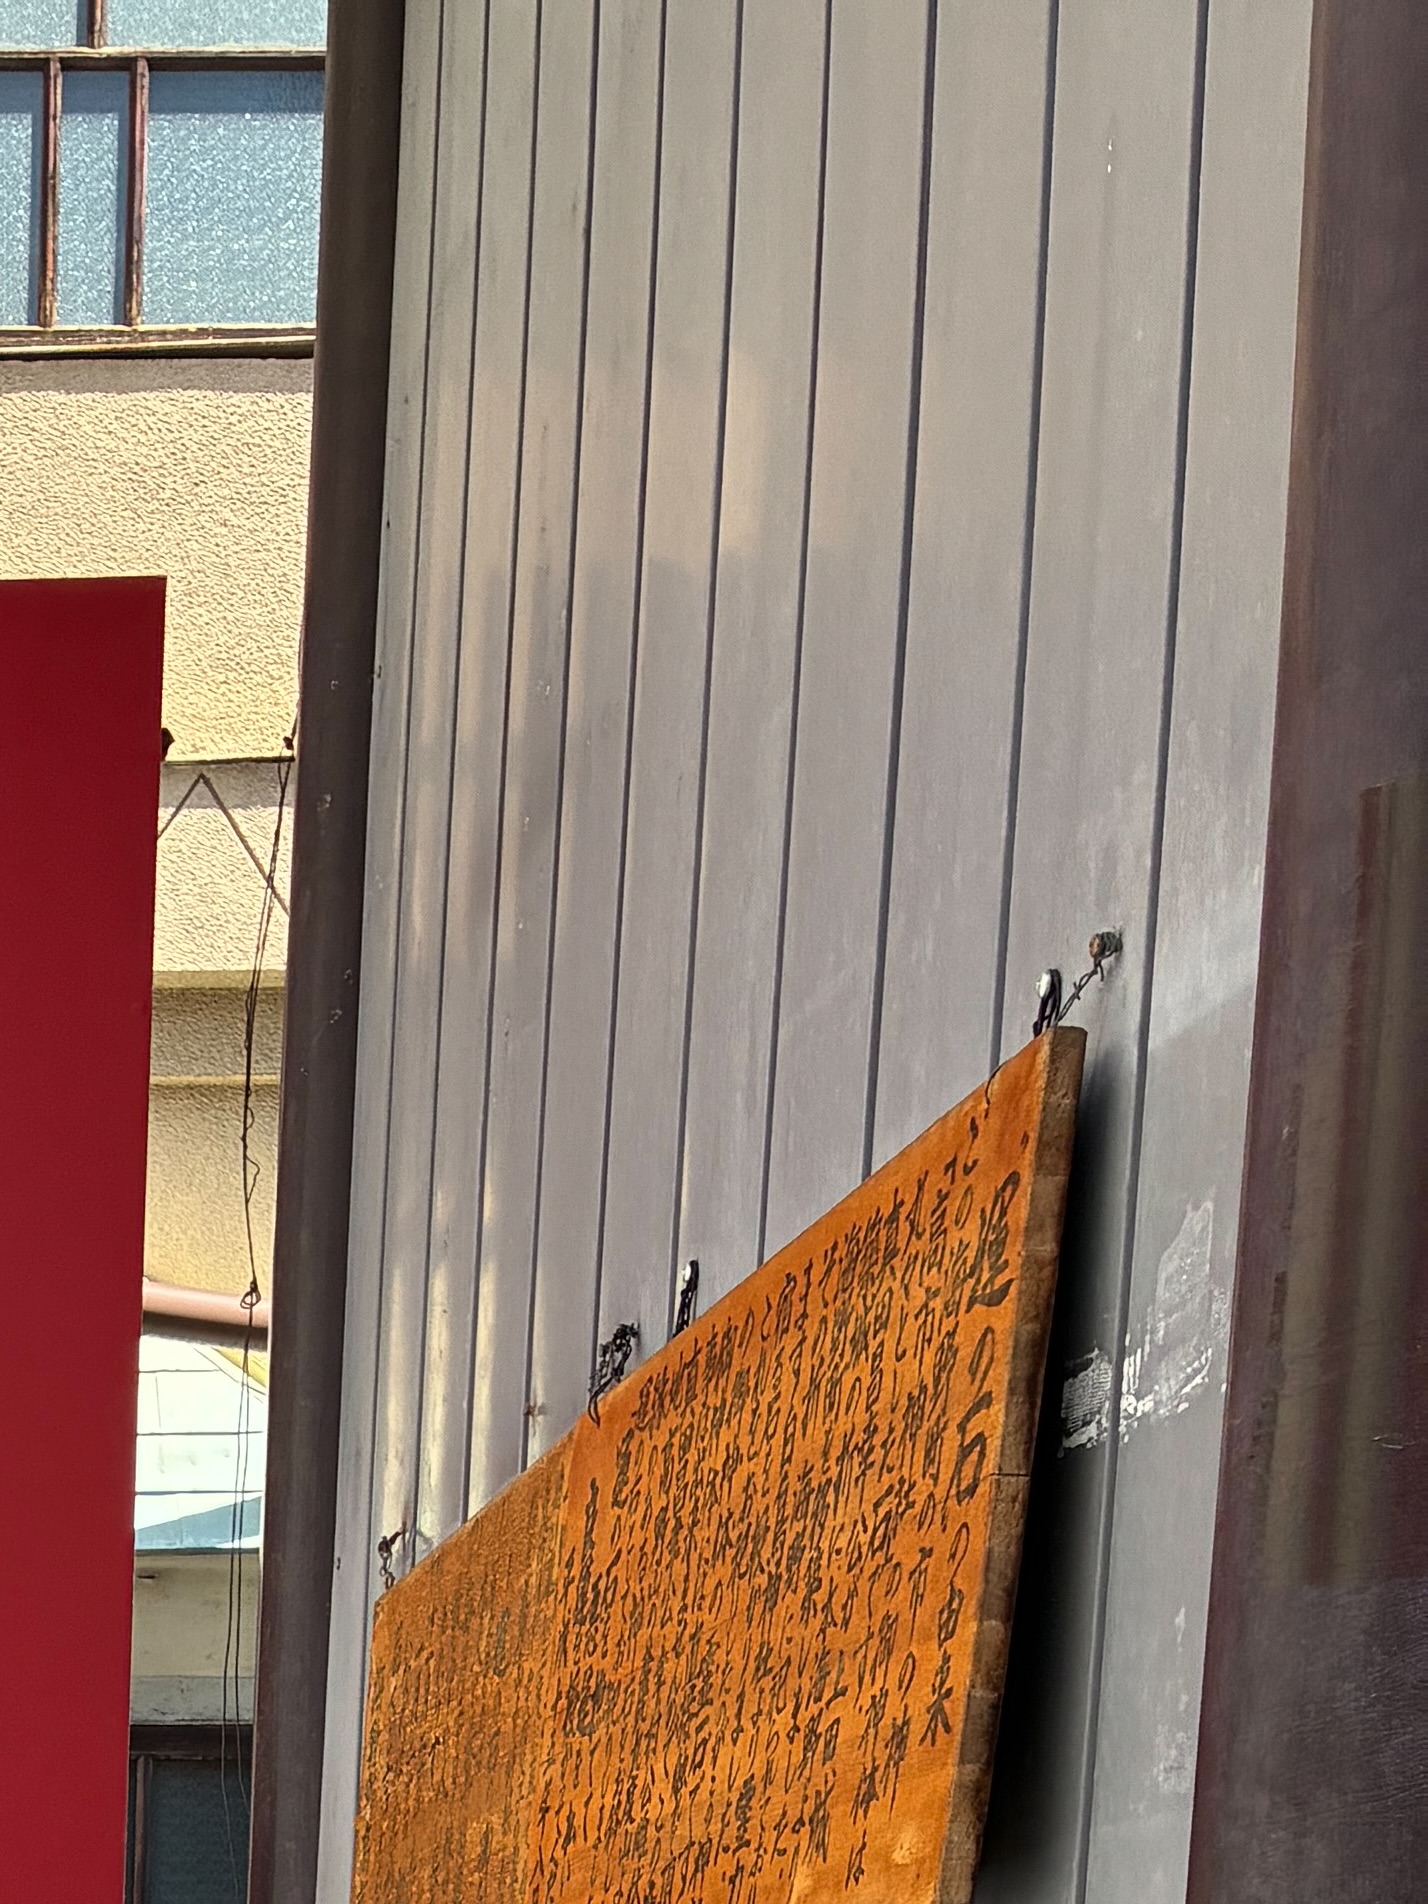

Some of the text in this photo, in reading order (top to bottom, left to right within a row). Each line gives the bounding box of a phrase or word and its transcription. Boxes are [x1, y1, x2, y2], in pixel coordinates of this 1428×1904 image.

[919, 1171, 1020, 1746] 運の石の由来
